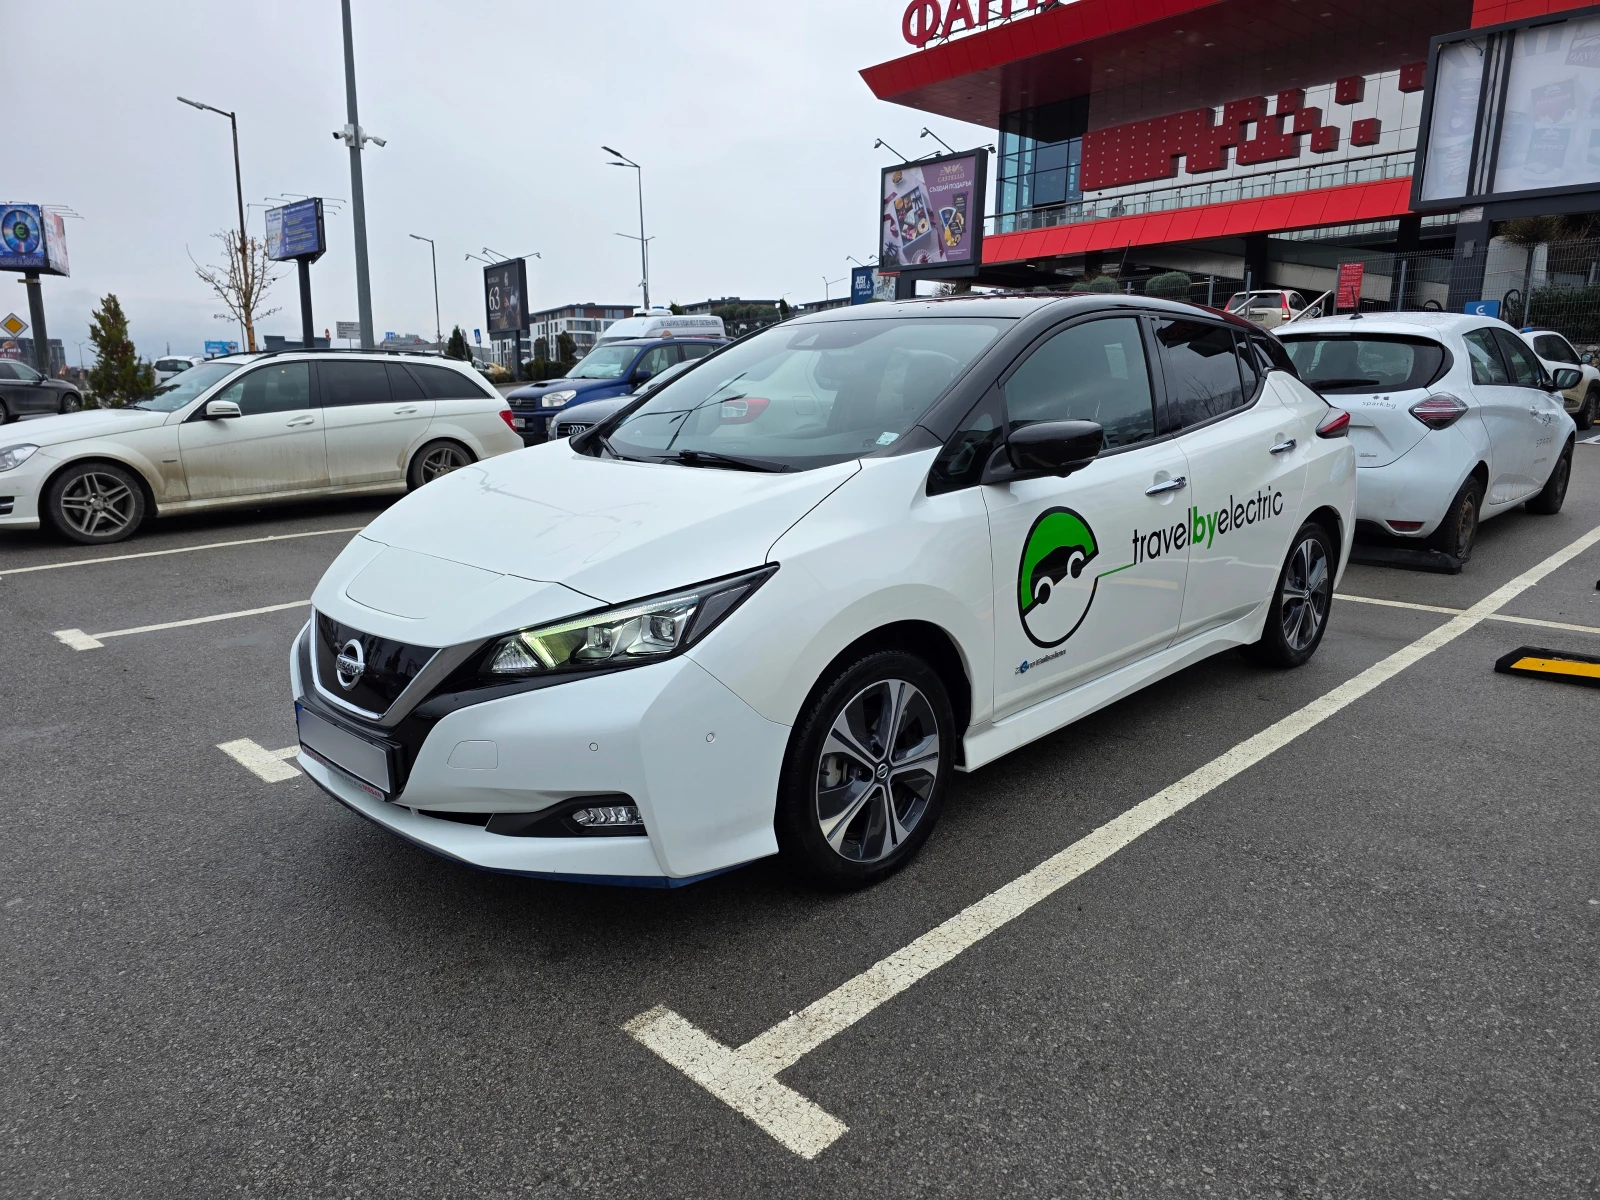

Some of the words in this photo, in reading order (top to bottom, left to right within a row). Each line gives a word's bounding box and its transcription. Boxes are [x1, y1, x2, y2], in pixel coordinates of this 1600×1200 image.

[938, 172, 965, 183] CASTELLO
[930, 183, 949, 193] СЪЗДАЙ
[949, 180, 973, 190] ПОДАРЪК
[489, 286, 501, 310] 63
[1362, 401, 1397, 409] spark.bg
[1132, 485, 1283, 565] travelbyelectric
[362, 784, 382, 798] NISSAN
